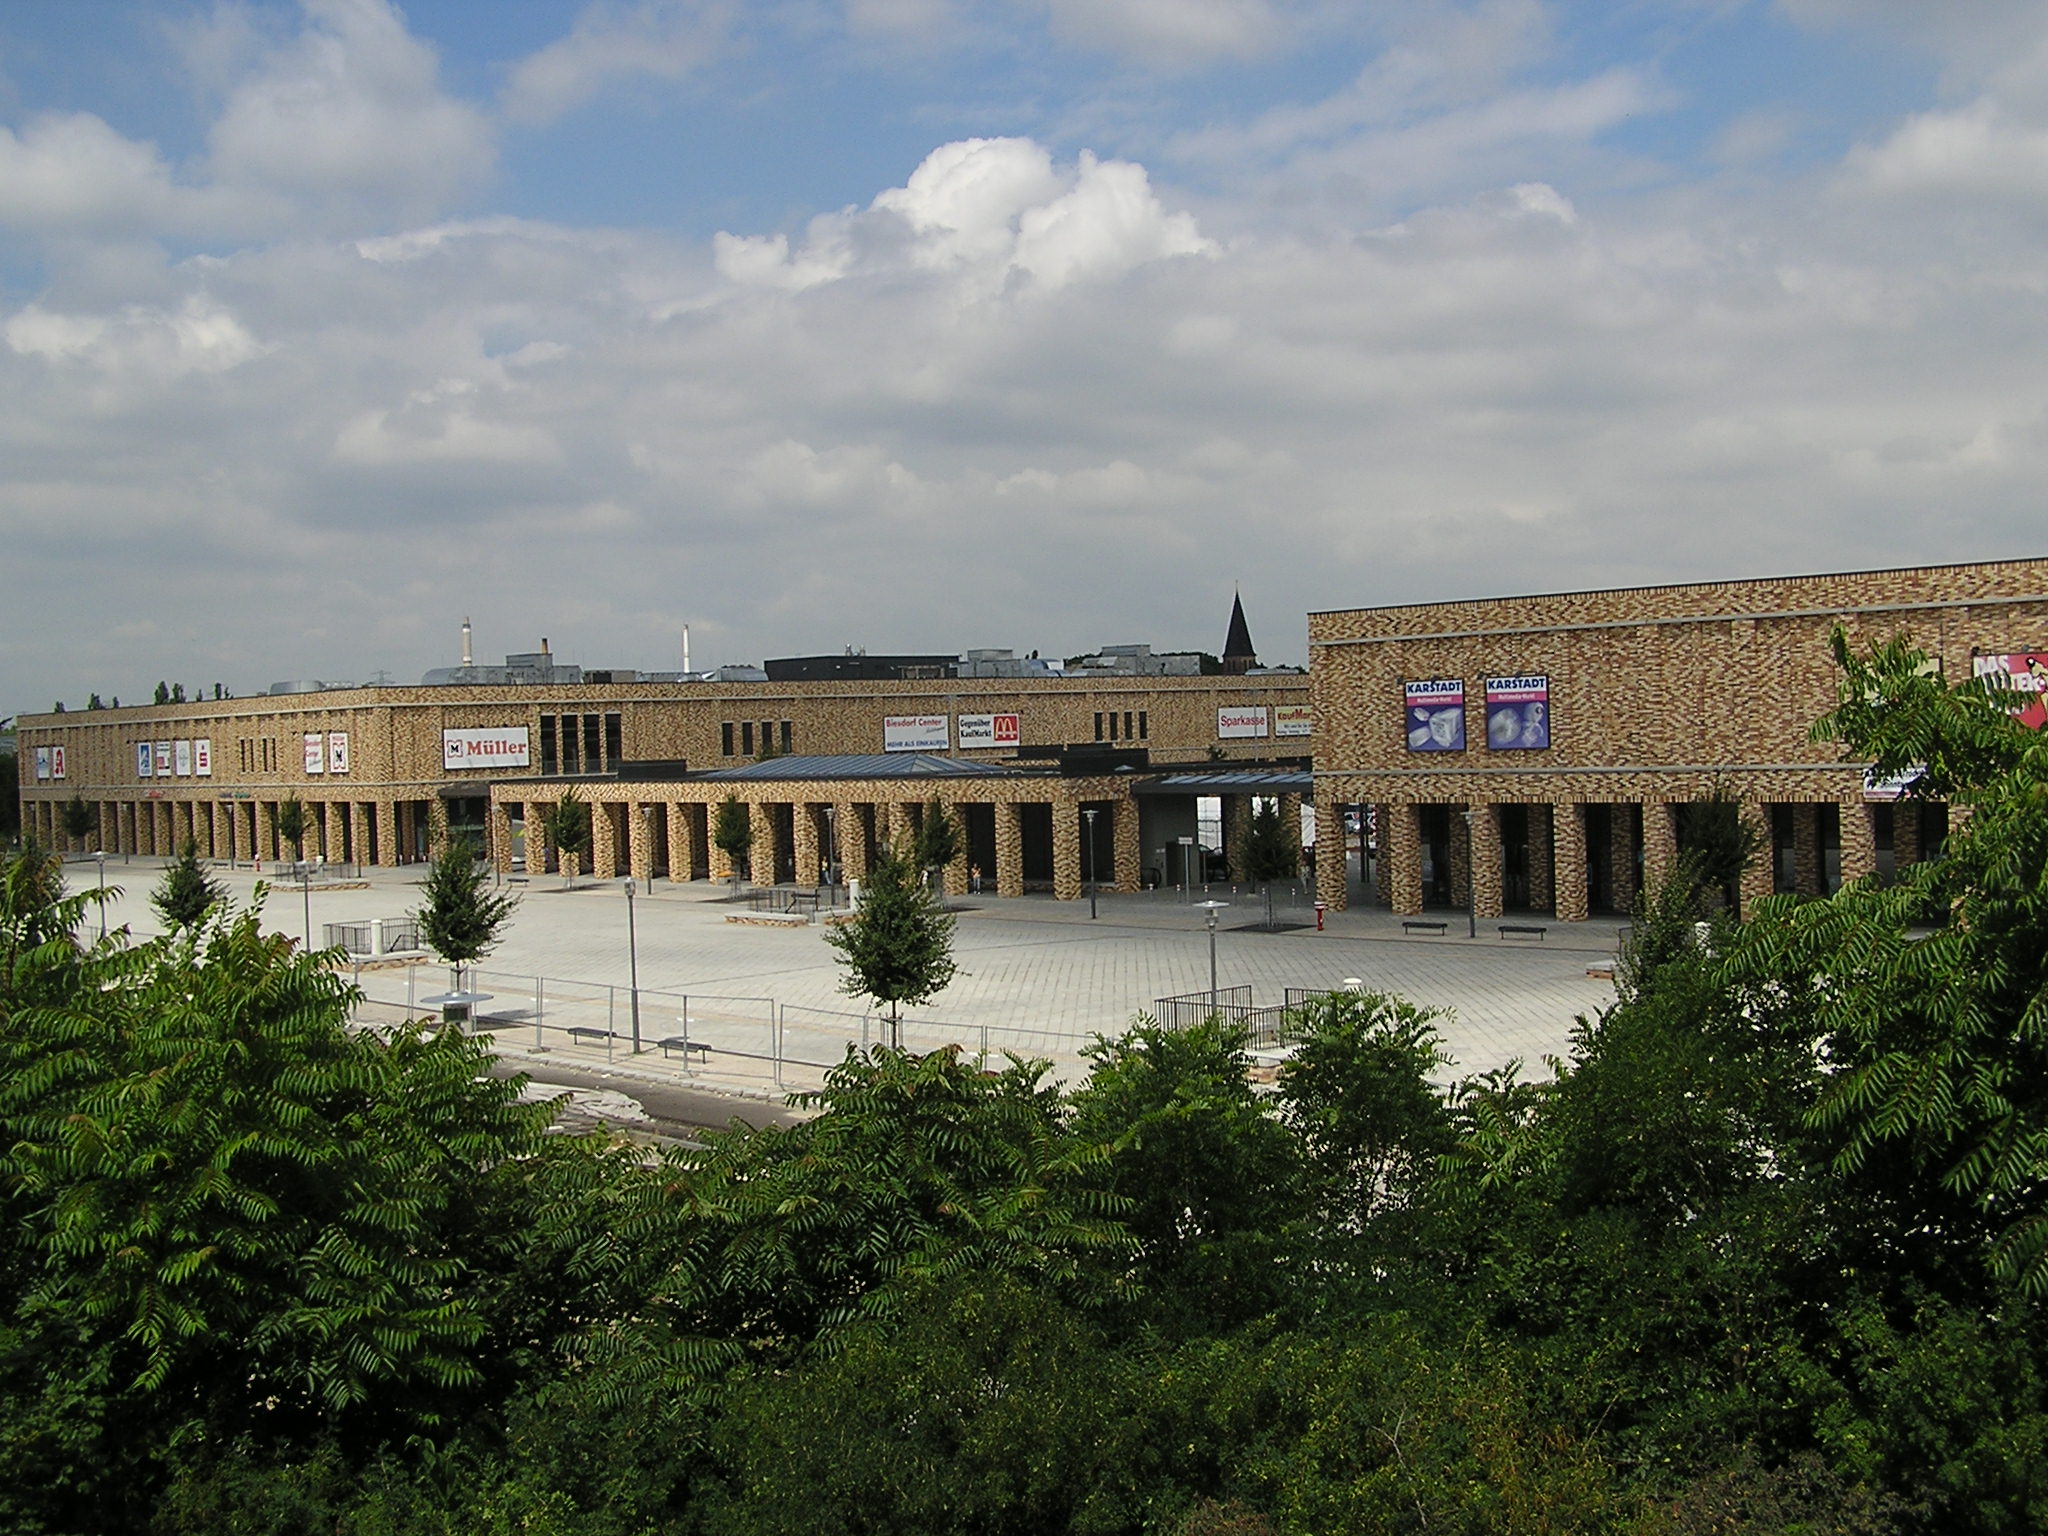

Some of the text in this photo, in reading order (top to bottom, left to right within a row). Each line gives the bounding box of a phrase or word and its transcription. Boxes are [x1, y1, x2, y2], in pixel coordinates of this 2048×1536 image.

[1974, 656, 2009, 676] DAS
[1407, 682, 1460, 693] KARSTADT
[1488, 678, 1545, 689] KARSTADT
[886, 718, 942, 727] Biesdorf Center
[1221, 715, 1265, 727] Sparkasse
[467, 740, 526, 755] Müller
